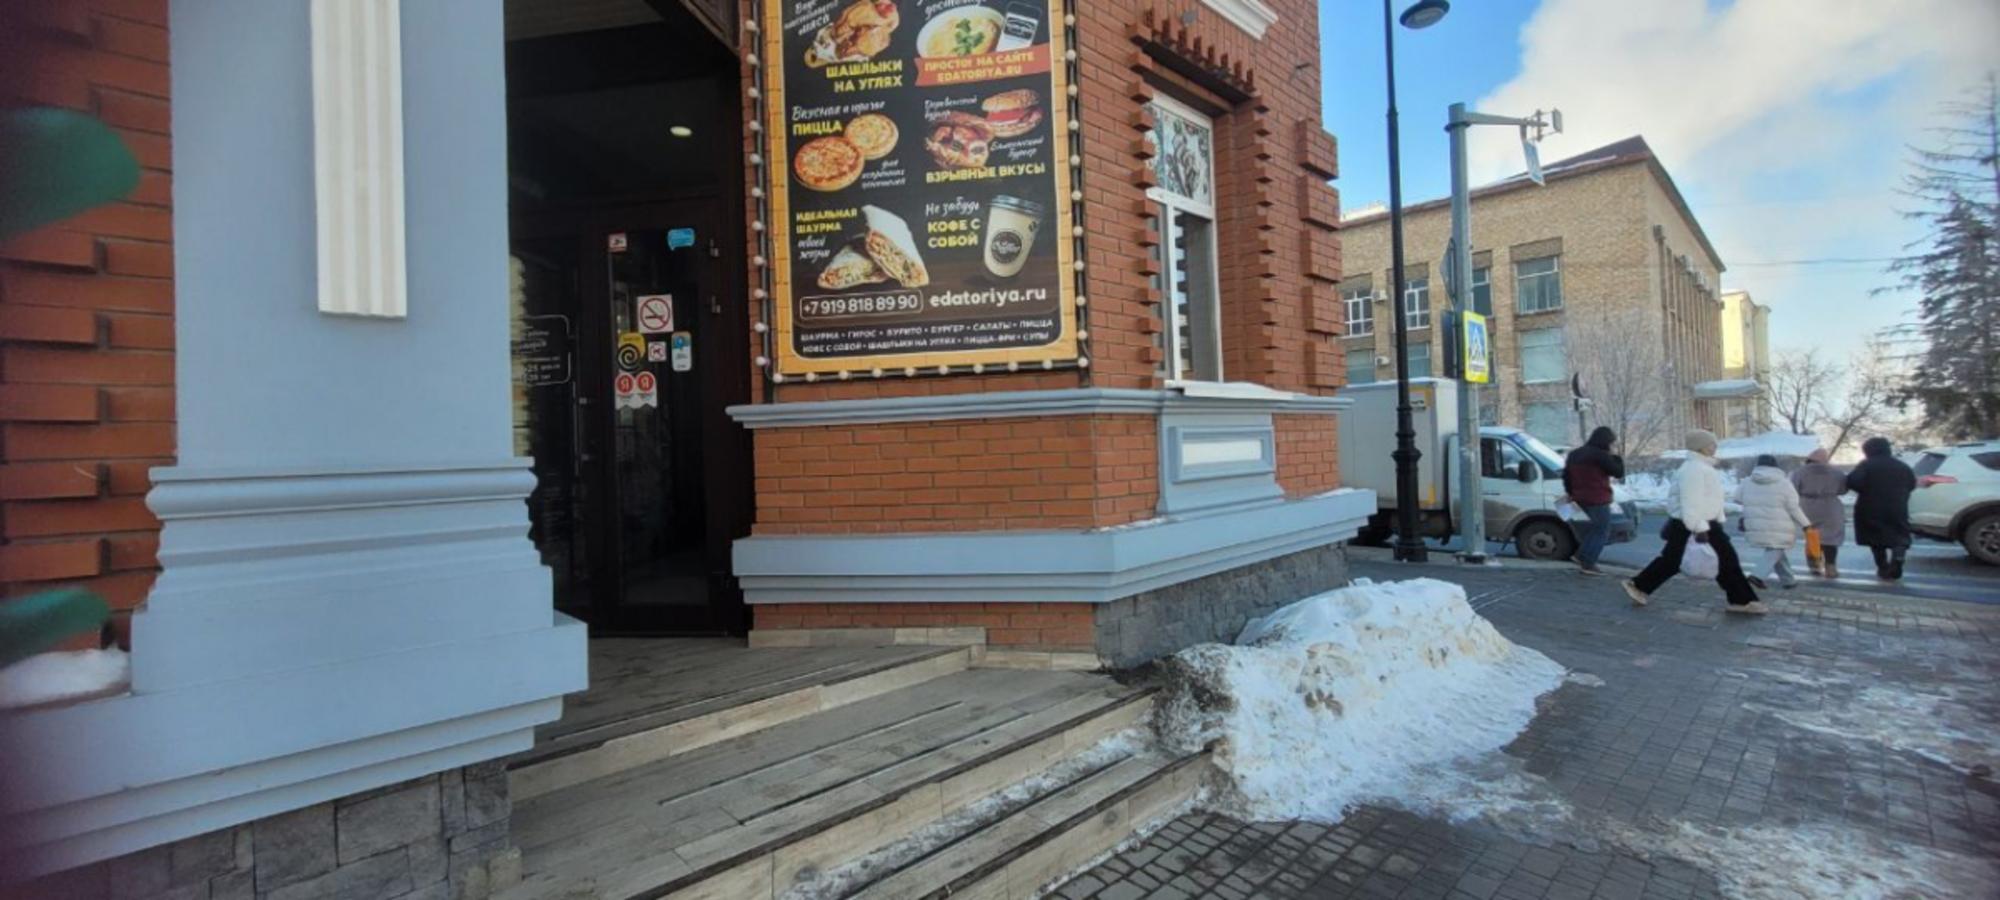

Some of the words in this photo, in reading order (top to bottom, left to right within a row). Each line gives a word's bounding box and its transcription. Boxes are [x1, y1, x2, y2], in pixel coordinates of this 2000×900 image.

[826, 60, 903, 78] ШАШЛЫКИ
[924, 59, 972, 72] ПРОСТО!
[976, 57, 993, 67] НА
[996, 51, 1035, 64] САЙТЕ
[938, 65, 1022, 83] EDATORIYA.RU
[834, 80, 855, 93] НА
[859, 75, 903, 91] УГЛЯХ
[791, 105, 841, 121] Вкусная
[793, 120, 843, 136] ПИЦЦА
[926, 165, 997, 183] ВЗРЫВНЫЕ
[999, 162, 1046, 176] ВКУСЫ
[796, 207, 858, 221] ИДЕАЛЬНАЯ
[925, 203, 940, 216] Не
[942, 196, 980, 217] забудь
[796, 222, 842, 235] ШАУРМА
[928, 219, 968, 233] КОФЕ
[970, 218, 981, 230] С
[928, 232, 979, 248] СОБОЙ
[804, 301, 819, 315] +7
[821, 299, 846, 315] 919
[848, 298, 874, 313] 818
[876, 296, 896, 311] 89
[898, 294, 918, 309] 90
[929, 287, 1047, 308] edatoriya.ru
[801, 331, 839, 341] ШАУРМА
[848, 329, 877, 339] ГИРОС
[931, 324, 965, 334] БУРГЕР
[973, 321, 1012, 332] САЛАТЫ
[1020, 319, 1053, 329] ПИЦЦА
